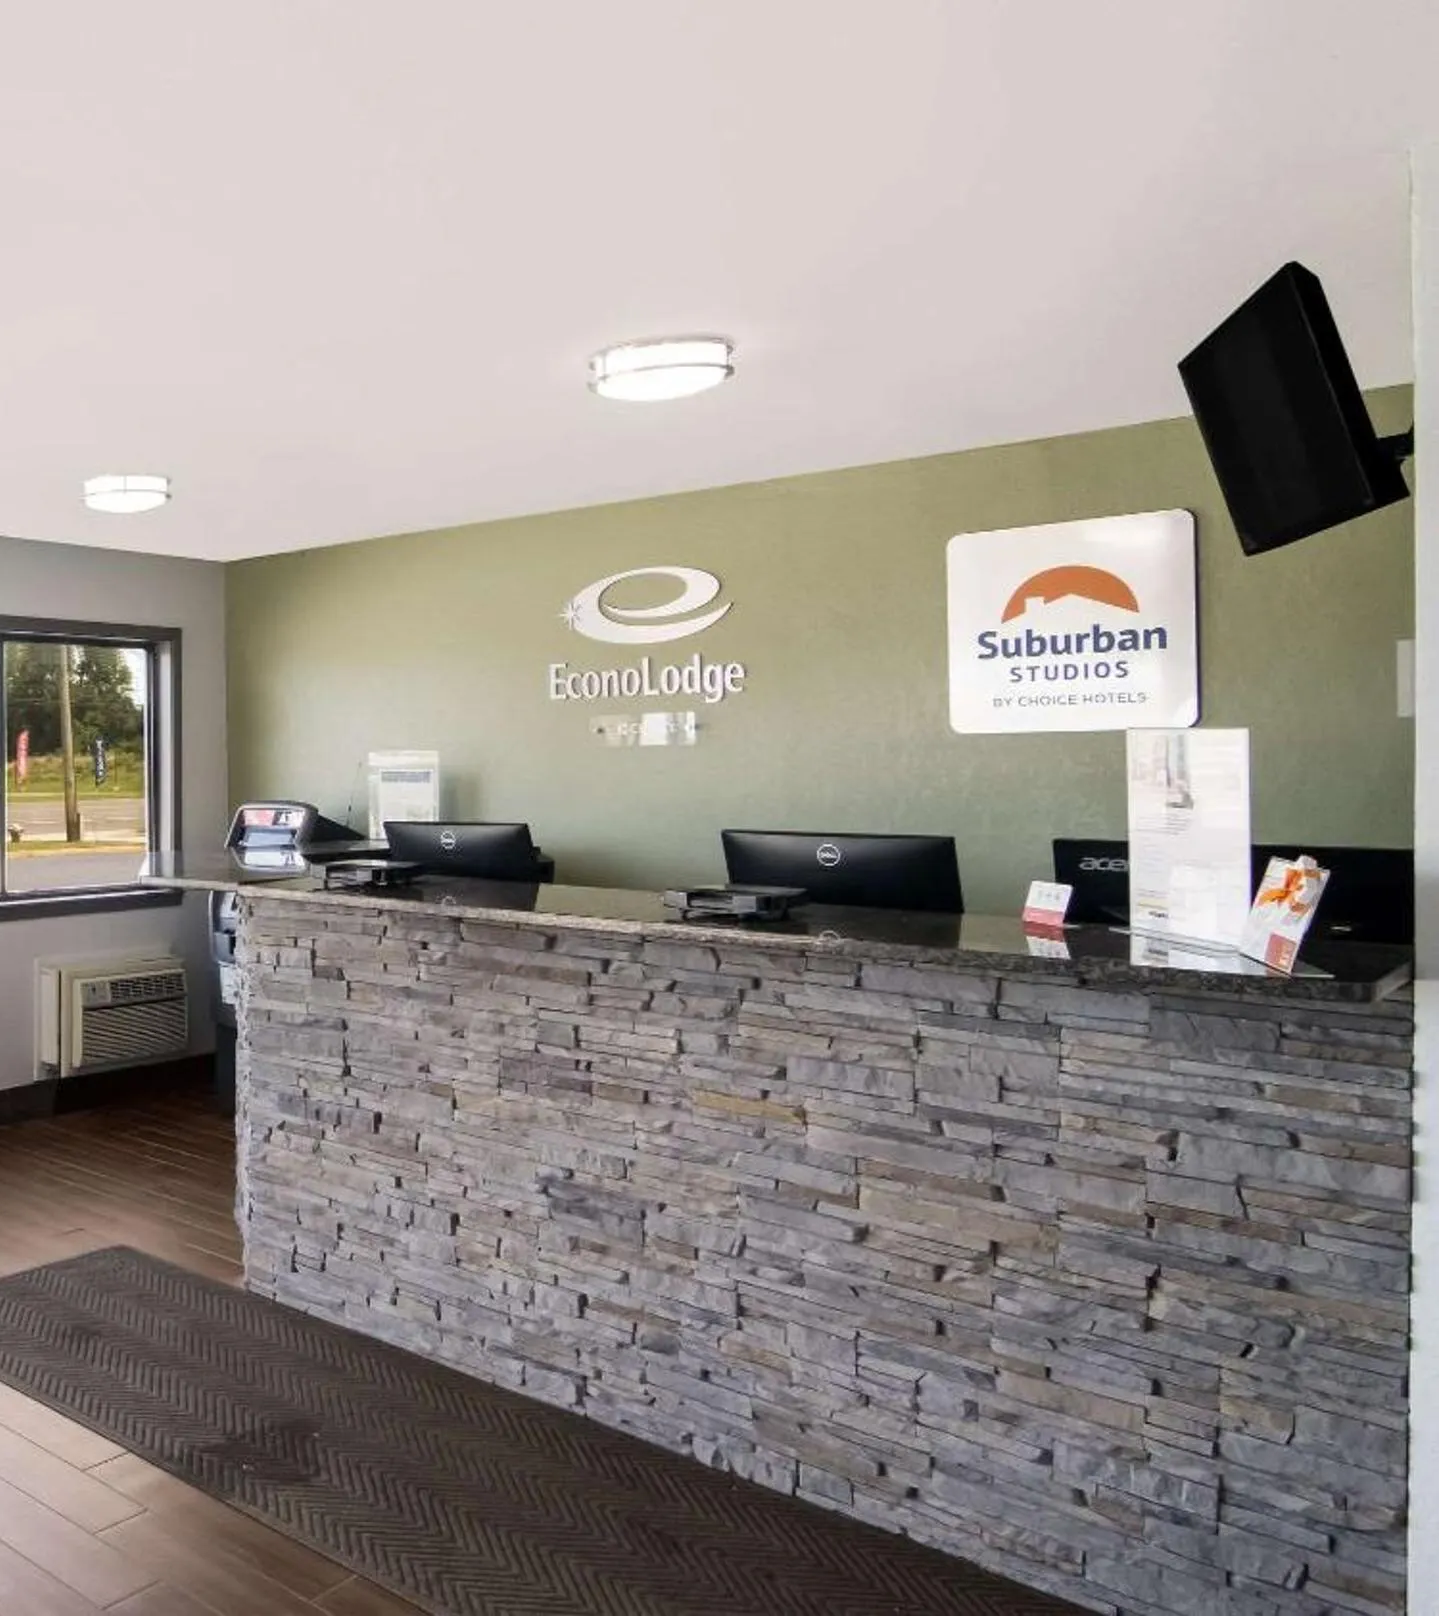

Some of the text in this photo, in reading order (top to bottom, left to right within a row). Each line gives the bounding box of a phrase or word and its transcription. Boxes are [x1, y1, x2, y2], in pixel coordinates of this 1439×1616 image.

[977, 624, 1168, 660] Suburban
[549, 652, 746, 703] EconoLodge
[1009, 660, 1129, 683] STUDIOS
[992, 691, 1147, 708] BY CHOICE HOTELS
[1078, 857, 1129, 872] ace
